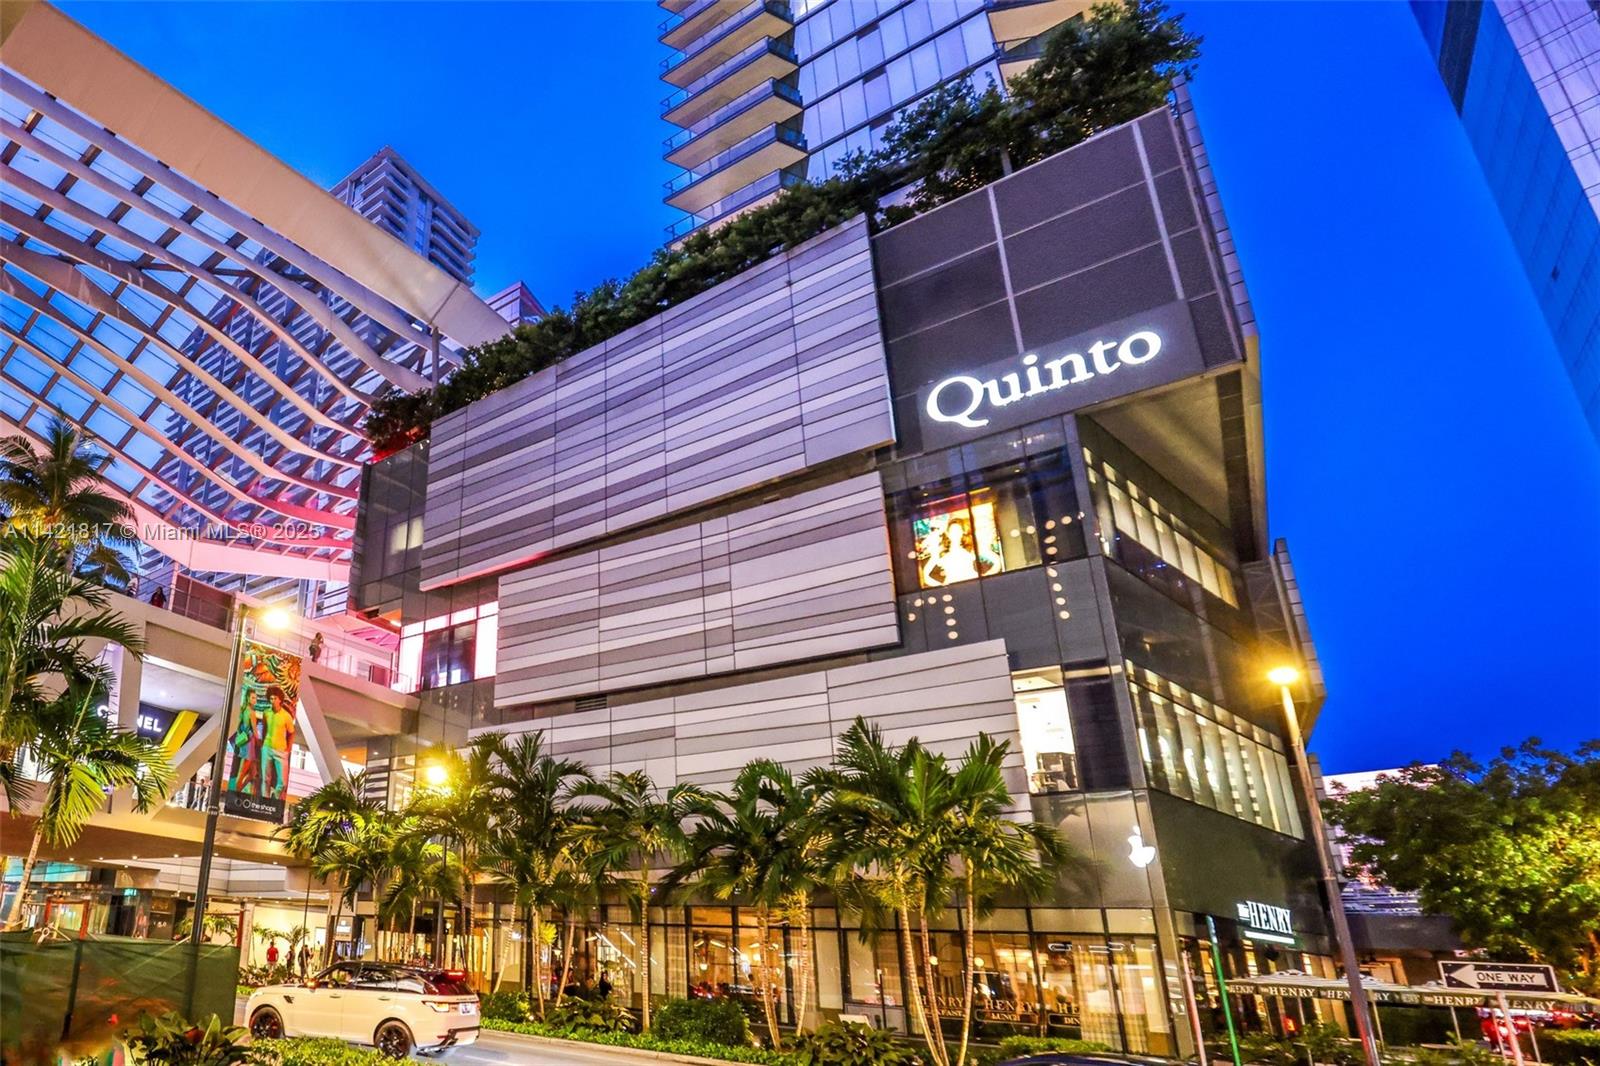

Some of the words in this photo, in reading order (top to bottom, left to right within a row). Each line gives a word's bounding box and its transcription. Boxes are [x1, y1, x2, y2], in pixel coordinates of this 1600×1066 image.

[926, 331, 1162, 427] Quinto
[1246, 900, 1293, 934] HENRY
[1477, 972, 1504, 982] ONE
[1508, 974, 1536, 983] WAY
[1269, 986, 1316, 997] HENRY
[1433, 995, 1482, 1006] HENRY
[1512, 1000, 1556, 1010] ENRY
